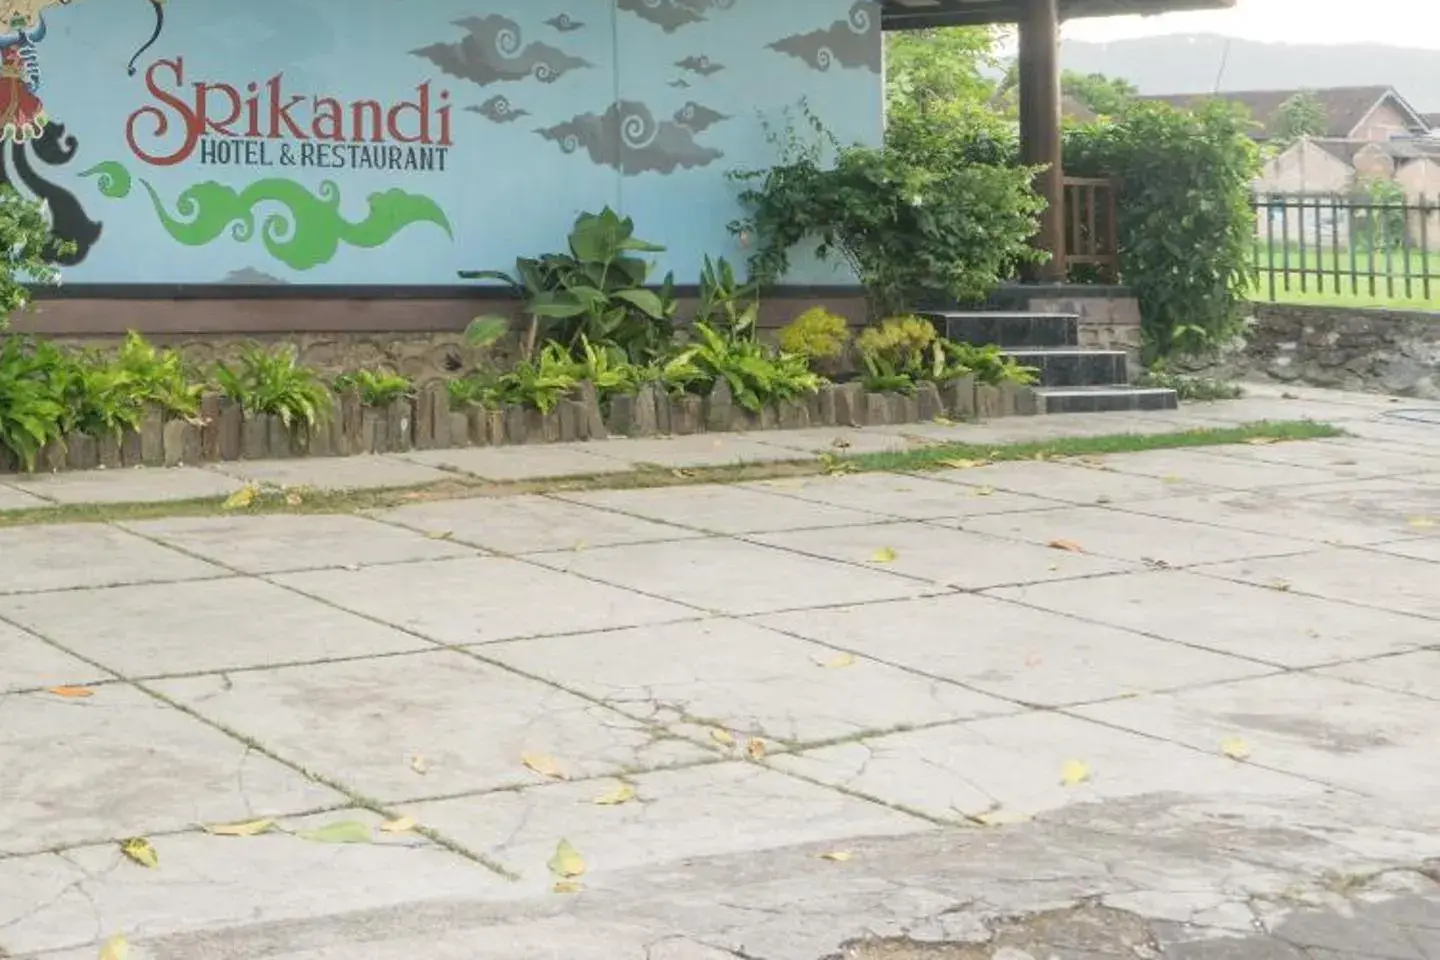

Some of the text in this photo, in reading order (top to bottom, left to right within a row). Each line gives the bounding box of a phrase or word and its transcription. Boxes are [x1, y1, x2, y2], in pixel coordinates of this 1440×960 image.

[201, 139, 448, 171] HOTEL & RESTAURANT
